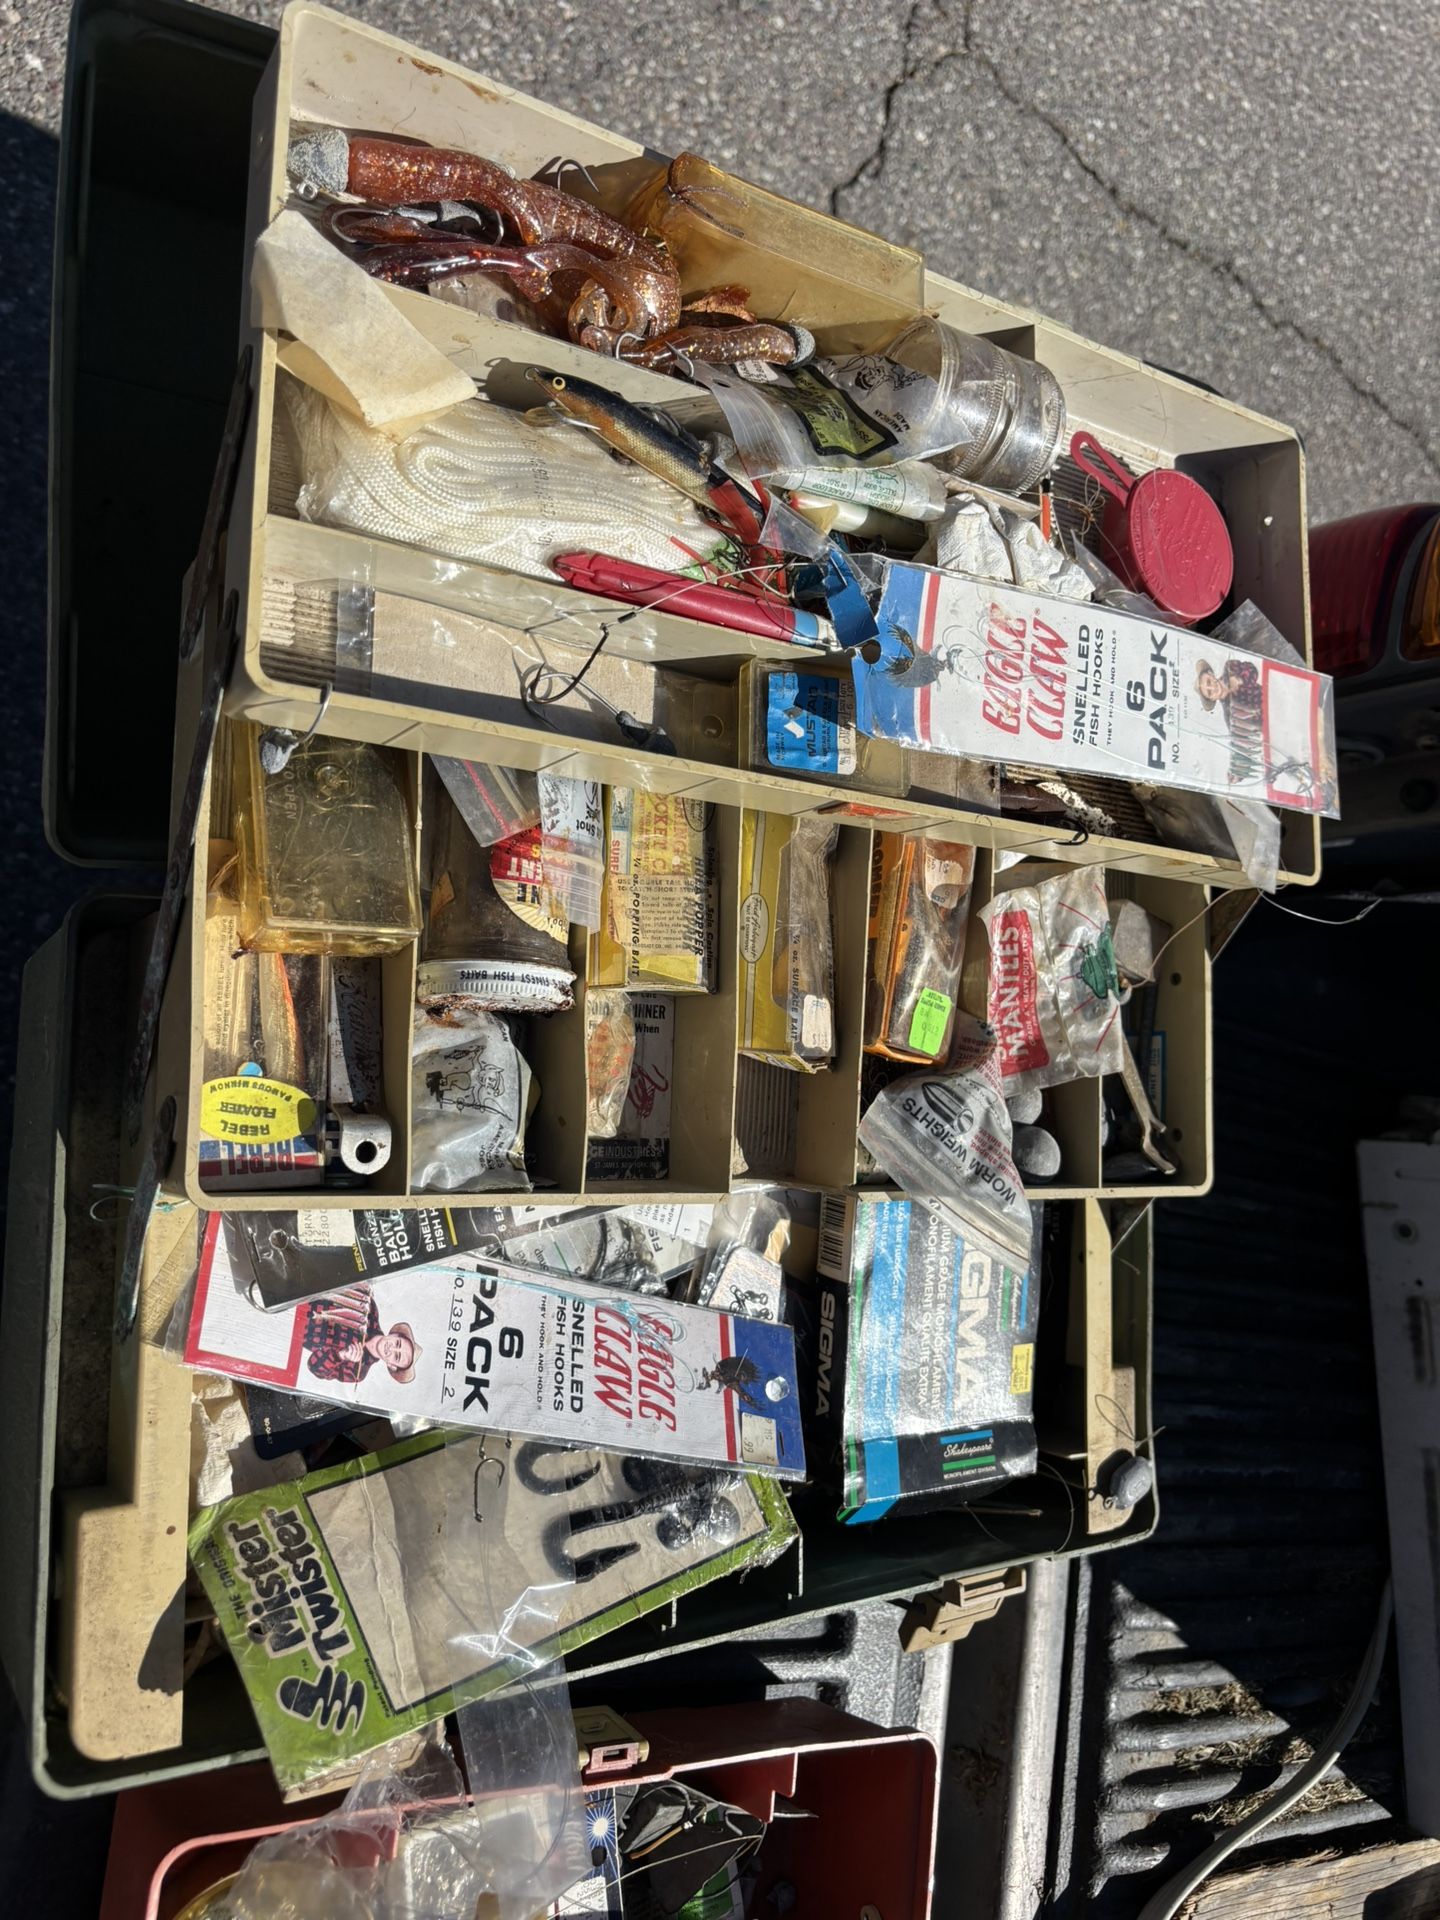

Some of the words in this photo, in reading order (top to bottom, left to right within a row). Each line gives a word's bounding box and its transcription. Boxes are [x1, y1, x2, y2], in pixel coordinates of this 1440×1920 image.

[874, 409, 903, 433] AMERICAN
[893, 412, 911, 431] MADE
[982, 602, 1027, 735] EAGLE
[1026, 616, 1069, 740] CLAW
[1092, 627, 1104, 697] HOOKS
[1072, 624, 1090, 745] SNELLED
[1126, 680, 1146, 712] 6
[1147, 630, 1168, 770] PACK
[1171, 668, 1181, 699] SIZE
[806, 686, 818, 757] MUSTAD
[1089, 704, 1100, 746] FISH
[1106, 721, 1114, 746] THEY
[1171, 741, 1181, 764] NO.
[283, 783, 298, 820] OPEN
[575, 819, 596, 837] Shot
[631, 892, 642, 945] POPPING
[693, 902, 705, 957] POPPER
[460, 969, 488, 980] BAITS
[493, 971, 515, 982] FISH
[520, 973, 550, 987] FINEST
[630, 949, 641, 977] BAIT
[791, 967, 800, 1013] SURFACE
[998, 926, 1030, 1060] MANTLES
[635, 1022, 661, 1035] When
[791, 1017, 799, 1042] BAIT
[209, 1079, 250, 1094] MINNOW
[252, 1082, 293, 1102] FAMOUS
[219, 1101, 277, 1119] FLOATER
[219, 1119, 271, 1137] REBEL
[901, 1097, 967, 1162] WEIGHTS
[968, 1158, 1017, 1205] WORM
[363, 1210, 389, 1267] BRONZE
[379, 1219, 401, 1265] BAIT
[434, 1219, 448, 1251] FISH
[924, 1202, 944, 1309] MONOFILAMENT
[936, 1254, 949, 1301] GRADE
[450, 1296, 464, 1332] 139
[538, 1294, 547, 1319] THEY
[555, 1294, 568, 1336] FISH
[461, 1263, 499, 1413] PACK
[498, 1326, 524, 1360] 6
[538, 1320, 547, 1350] HOOK
[443, 1337, 458, 1370] SIZE
[537, 1352, 545, 1373] AND
[569, 1299, 586, 1414] SNELLED
[593, 1305, 633, 1420] CLAW
[815, 1290, 837, 1418] SIGMA
[929, 1302, 946, 1411] MONOFILAMENT
[536, 1374, 544, 1403] HOLD
[552, 1343, 566, 1412] HOOKS
[637, 1312, 677, 1432] EAGLE
[917, 1366, 929, 1407] EXTRA
[443, 1386, 456, 1399] 2
[943, 1442, 994, 1459] Shakespeare
[227, 1521, 307, 1654] Mister
[264, 1507, 352, 1662] Twister
[228, 1594, 247, 1621] THE
[363, 1657, 380, 1692] Pending
